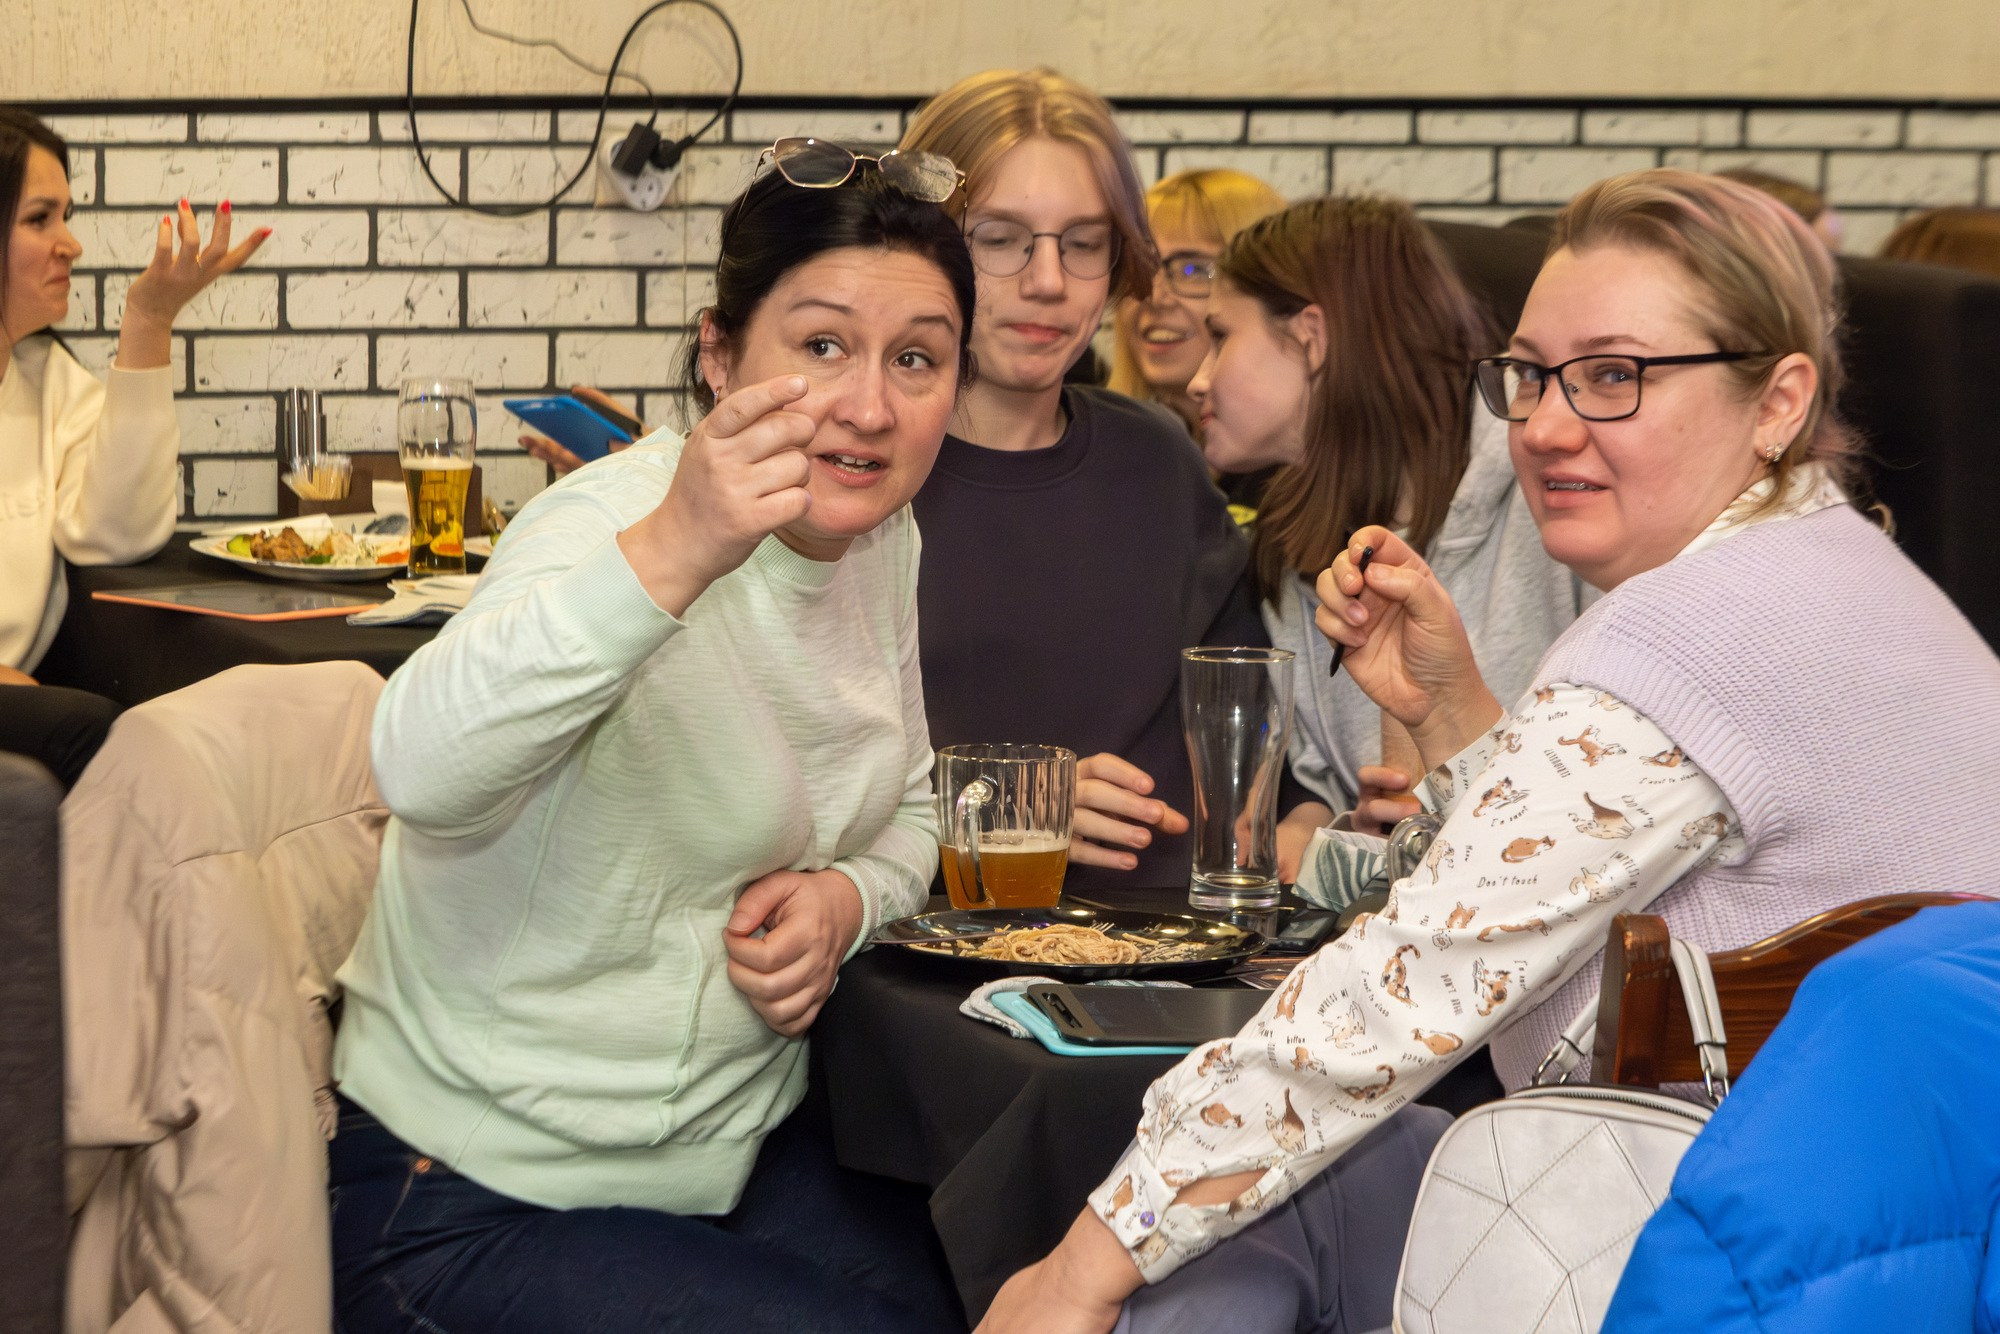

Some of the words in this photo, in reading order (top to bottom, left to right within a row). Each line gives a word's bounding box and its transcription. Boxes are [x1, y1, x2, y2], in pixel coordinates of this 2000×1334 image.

[1476, 876, 1508, 889] Don't
[1511, 874, 1538, 886] touch
[1317, 993, 1338, 1018] IMPRESS
